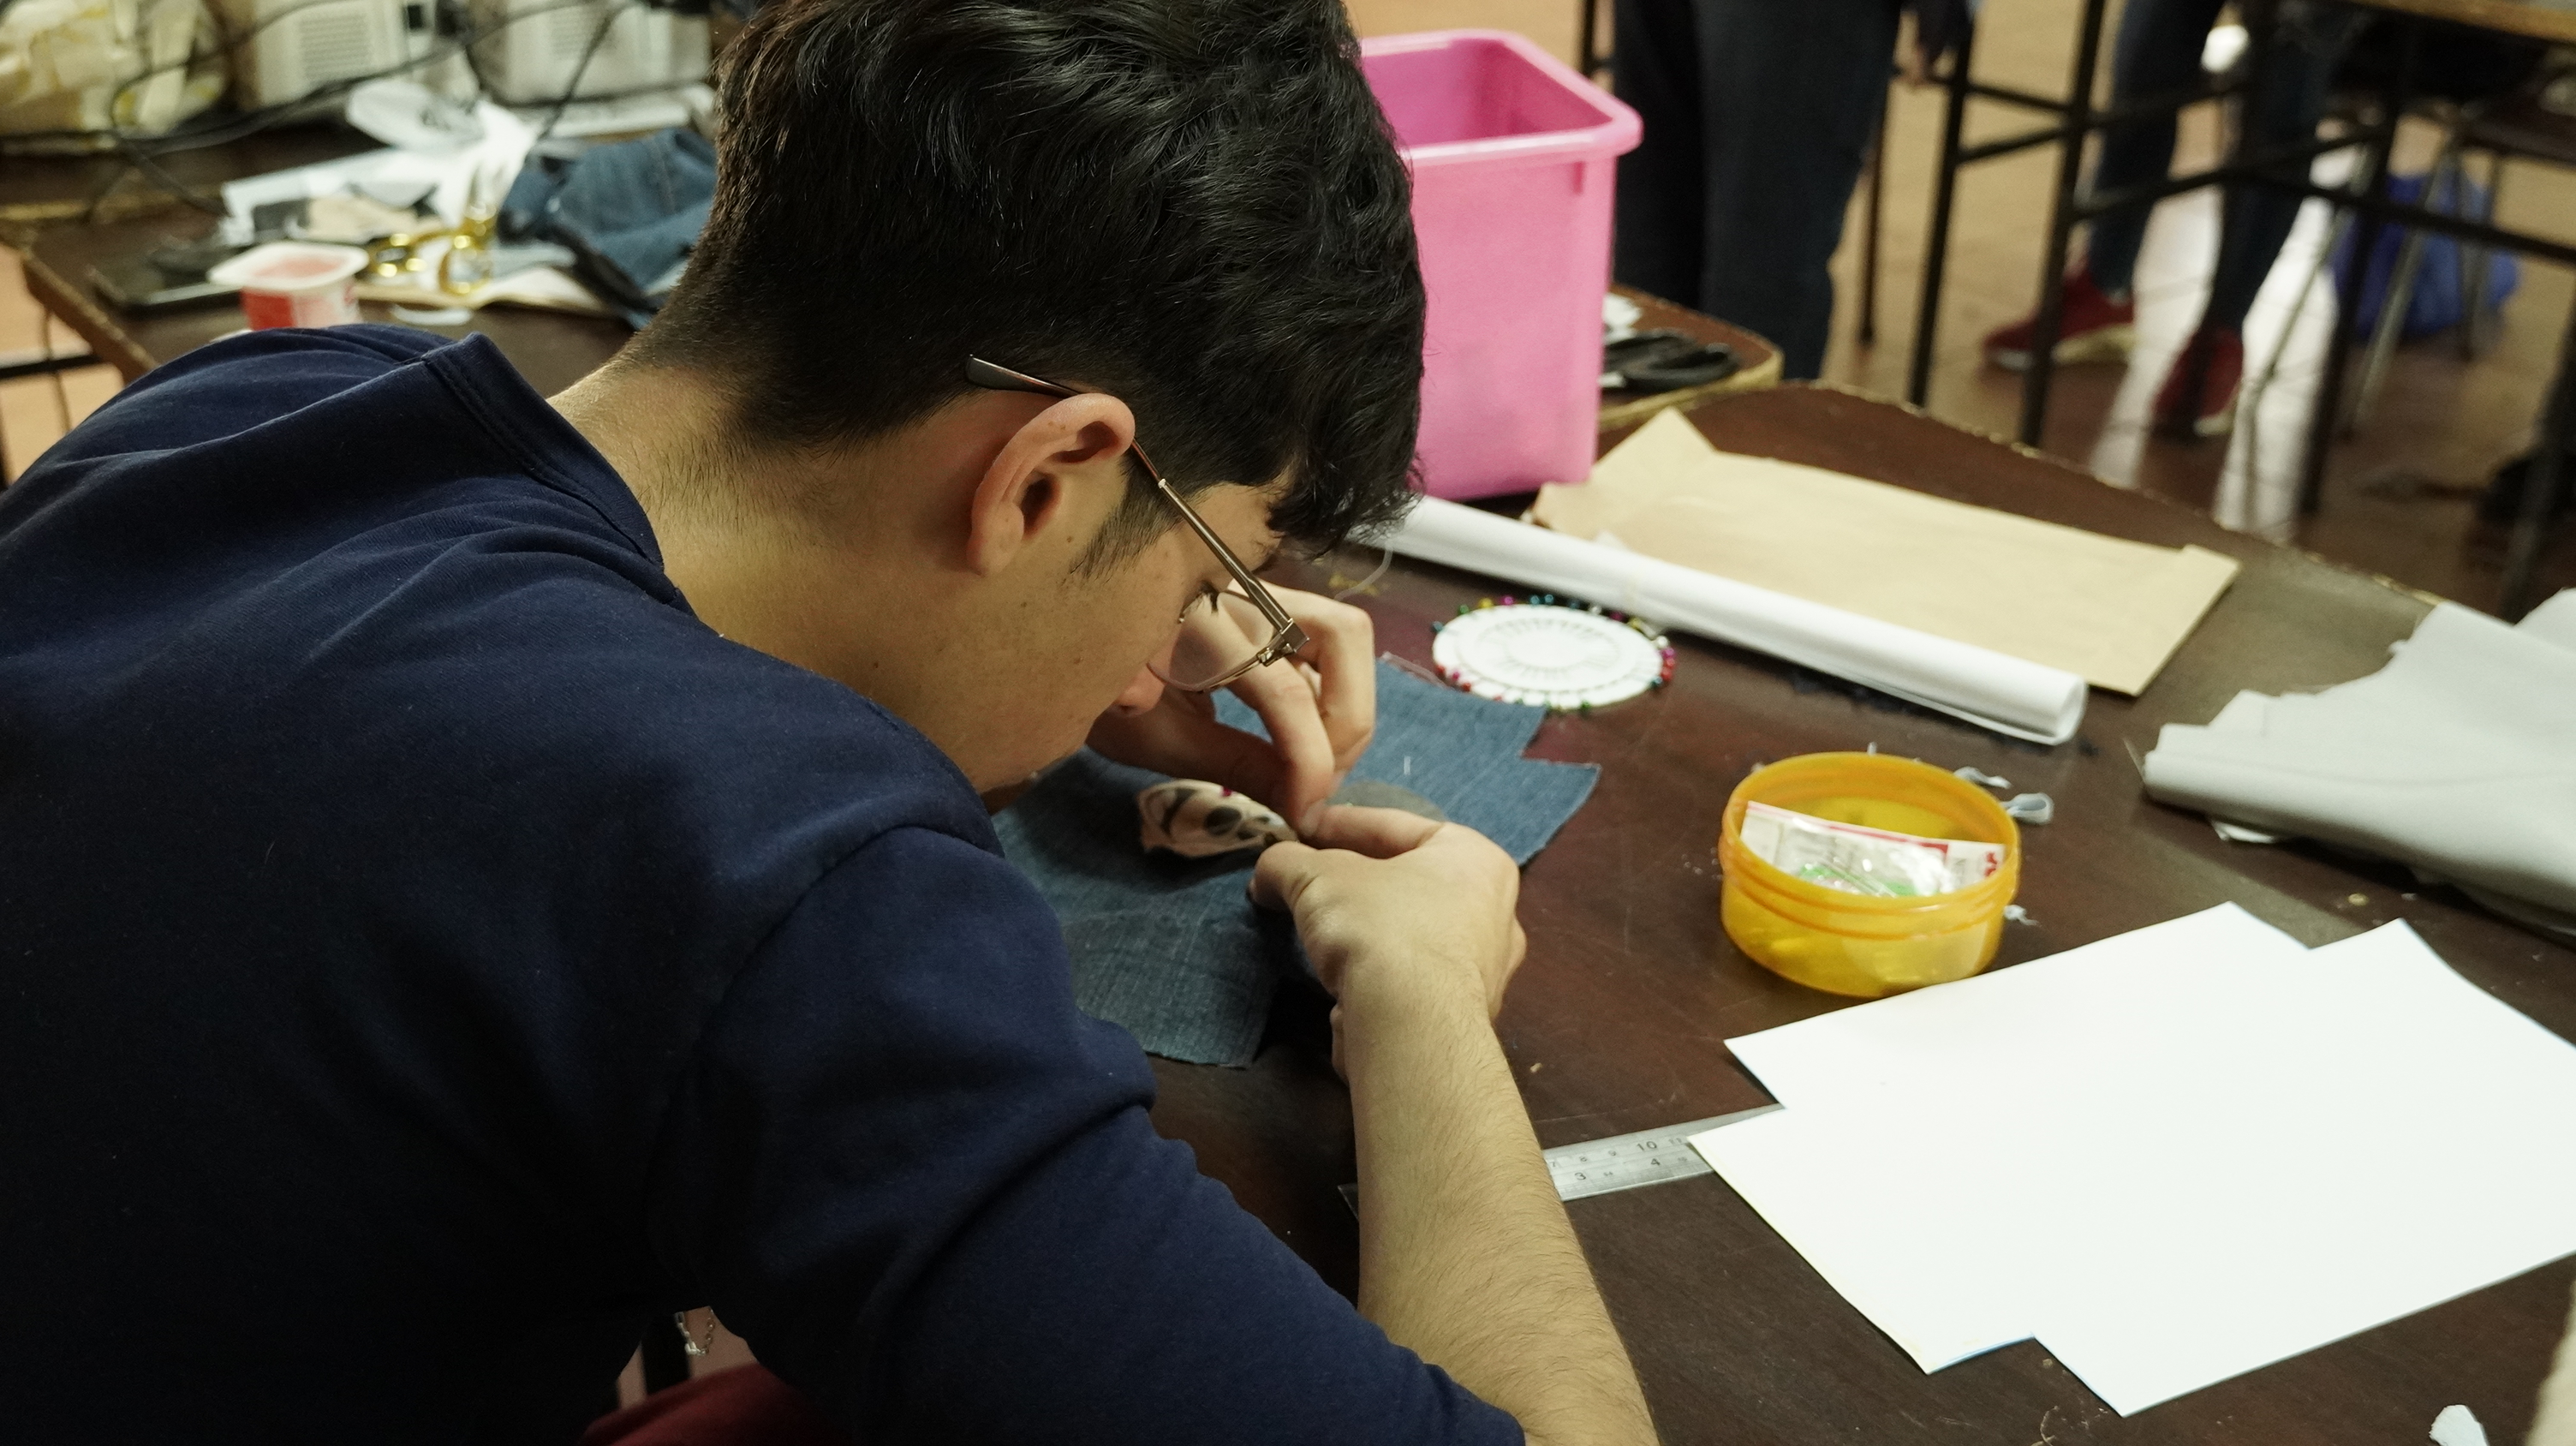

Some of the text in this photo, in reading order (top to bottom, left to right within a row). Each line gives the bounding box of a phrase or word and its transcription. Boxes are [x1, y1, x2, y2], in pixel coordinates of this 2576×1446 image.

[1637, 1140, 1658, 1151] 10
[1574, 1157, 1661, 1180] 3 4
